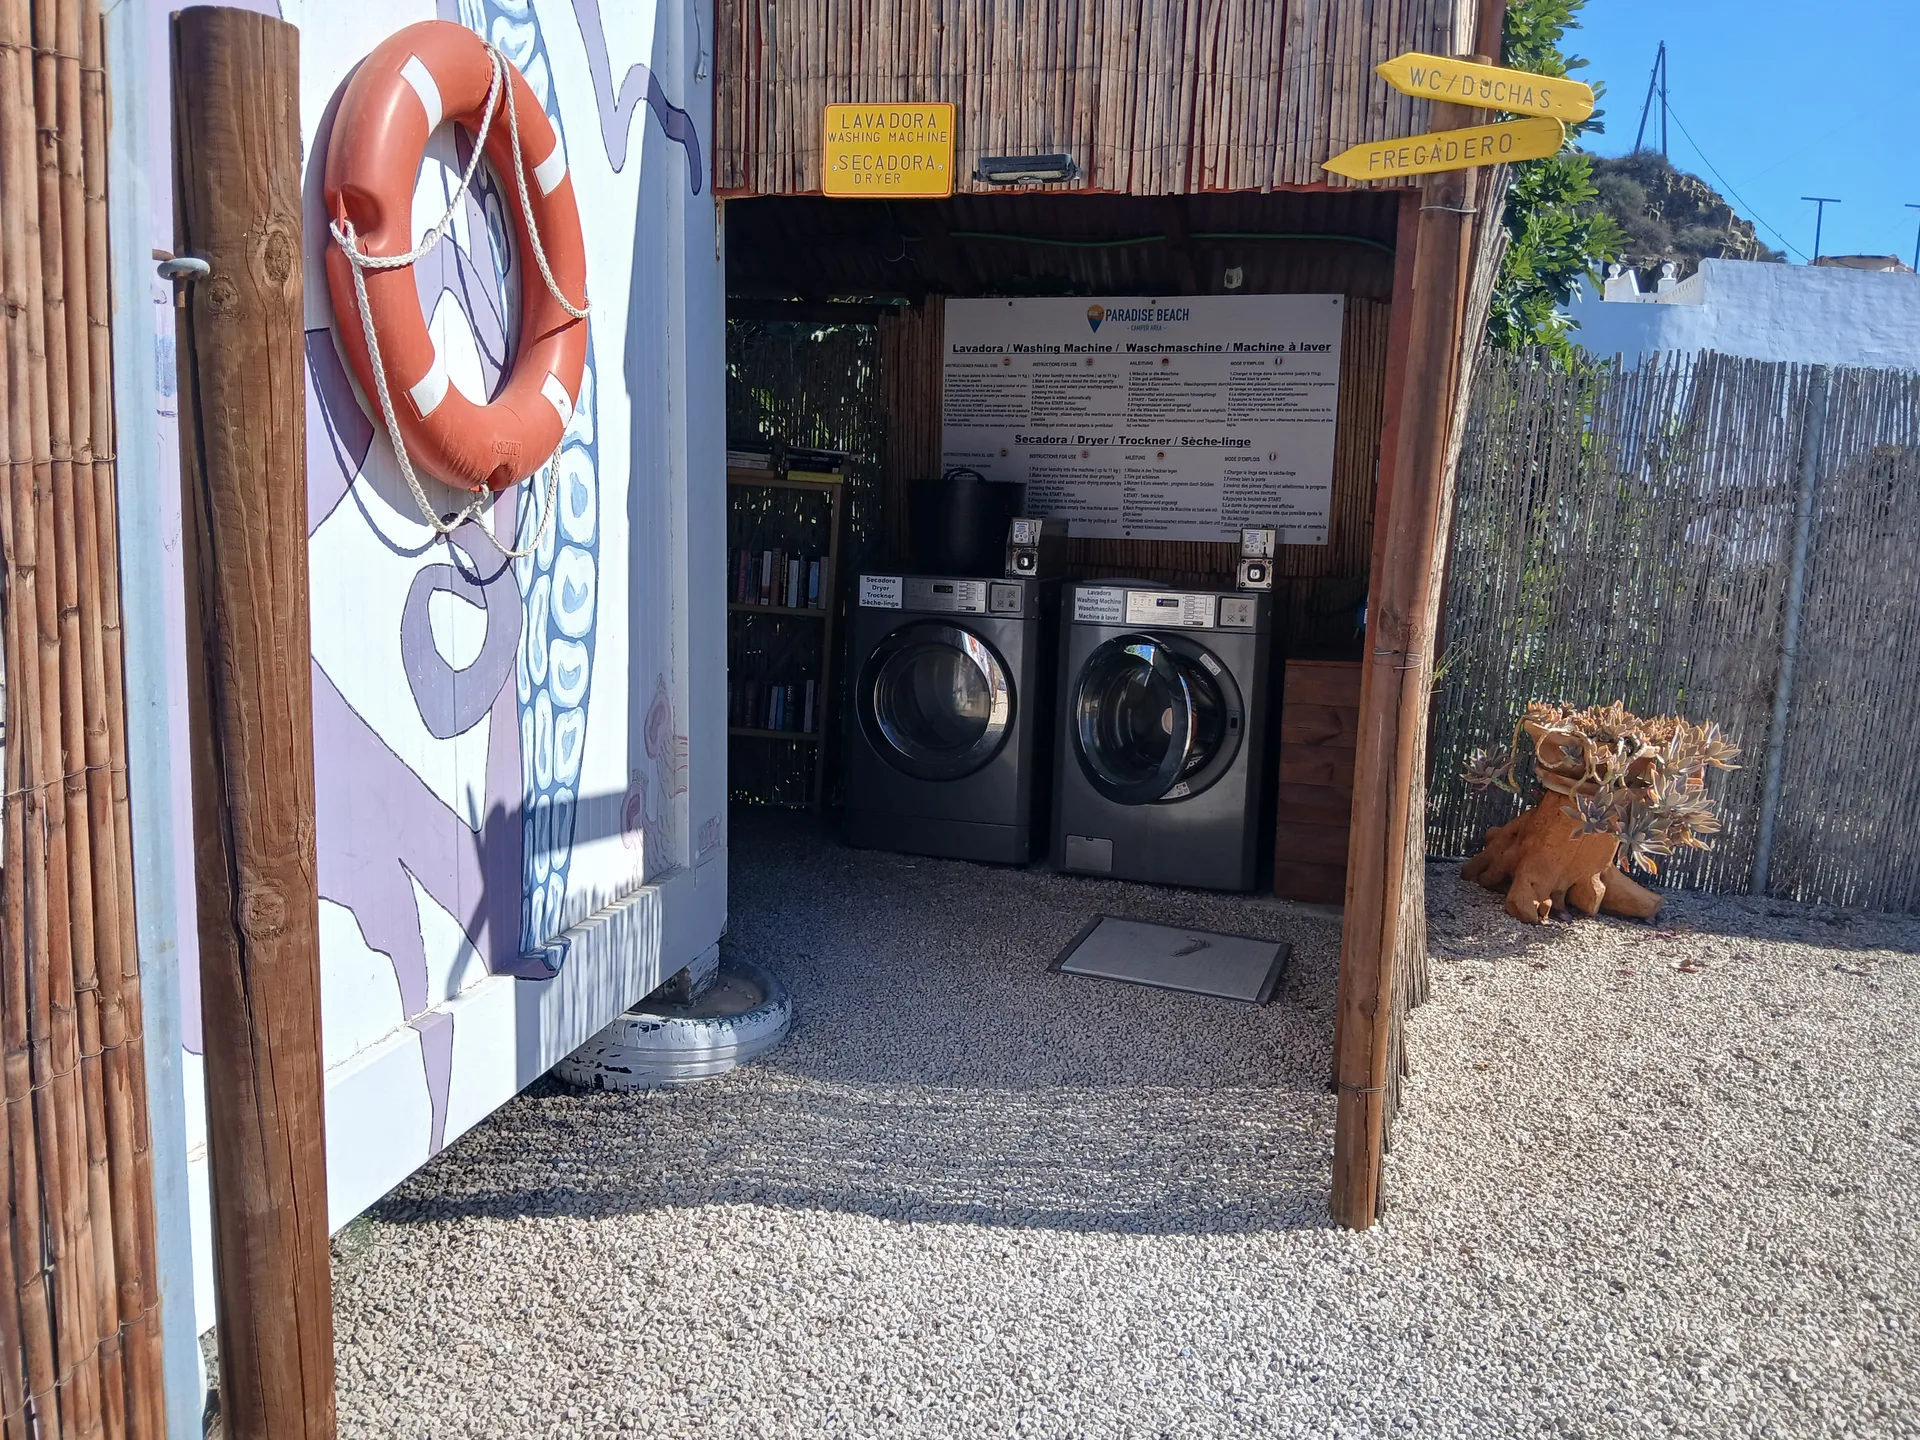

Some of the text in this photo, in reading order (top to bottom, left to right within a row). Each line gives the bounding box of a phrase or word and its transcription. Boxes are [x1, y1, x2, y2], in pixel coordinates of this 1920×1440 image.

[1409, 65, 1551, 109] WC/DUCHAS
[841, 112, 937, 129] LAVADORA
[828, 131, 947, 143] WASHING MACHINE
[1368, 132, 1513, 172] FREGADERO
[838, 154, 936, 171] SECADORA
[854, 173, 901, 185] DRYER
[1105, 308, 1189, 322] PARADISE BEACH
[952, 343, 1004, 353] Lavadora
[1013, 343, 1061, 355] Washing
[1063, 343, 1113, 353] Machine
[1126, 343, 1223, 352] Waschmaschine
[1232, 342, 1285, 352] Machine
[1288, 342, 1296, 352] à
[1299, 343, 1331, 352] laver
[1014, 435, 1068, 444] Secadora
[1077, 435, 1109, 447] Dryer
[1118, 436, 1171, 446] Trockner
[1181, 436, 1251, 448] Sèche-linge
[866, 576, 896, 584] Secadora
[872, 584, 890, 592] Dryer
[866, 591, 895, 599] Trockner
[1076, 596, 1098, 605] Washing
[861, 599, 899, 608] Sèche-linge
[1078, 605, 1120, 613] Waschmaschine
